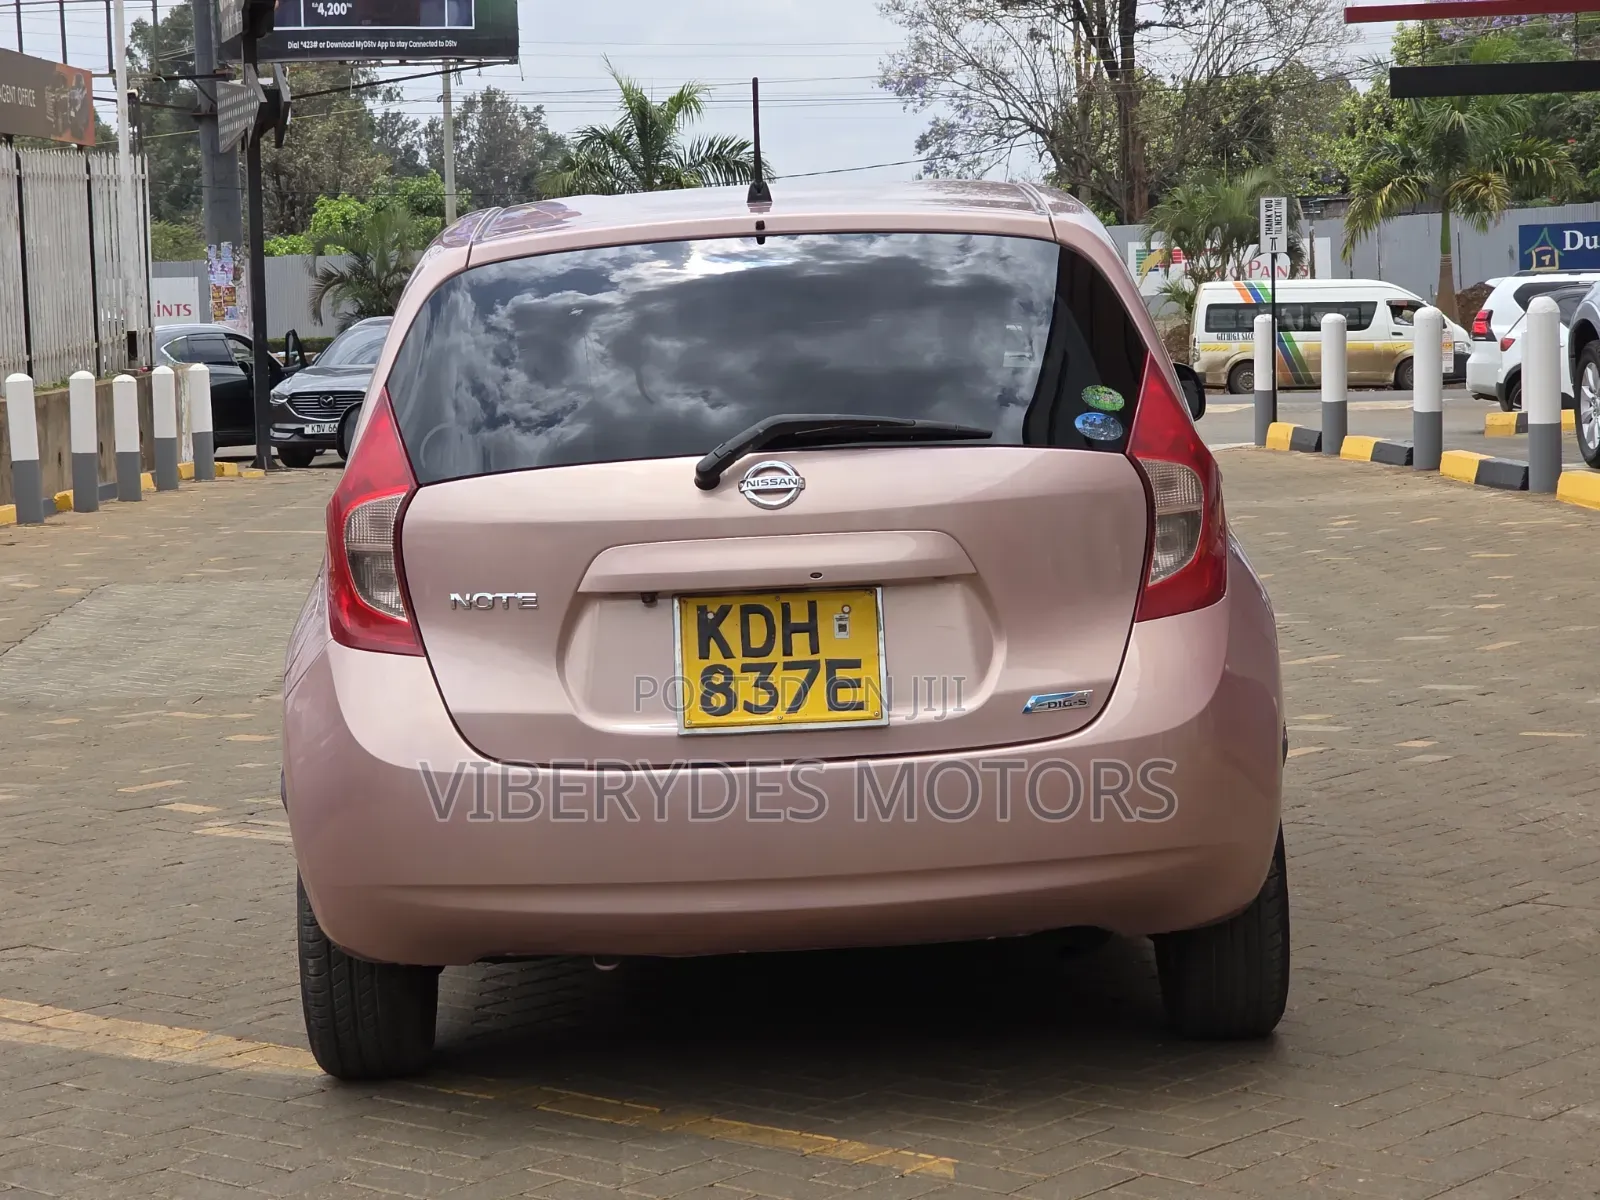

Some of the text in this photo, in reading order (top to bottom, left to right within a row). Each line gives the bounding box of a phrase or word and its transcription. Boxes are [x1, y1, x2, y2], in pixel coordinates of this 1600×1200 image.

[317, 2, 347, 17] 4,200
[287, 41, 300, 49] Dial
[326, 40, 355, 48] Download
[355, 40, 376, 50] MyDStv
[377, 40, 389, 50] App
[389, 40, 396, 48] to
[396, 40, 408, 50] stay
[408, 40, 438, 48] Connected
[438, 40, 445, 48] to
[445, 39, 458, 48] DStv
[17, 86, 36, 108] OFFICE
[1264, 199, 1274, 236] THANK YOU
[1274, 198, 1283, 236] TILL NEXT TIME
[1247, 260, 1309, 279] PANS
[1241, 332, 1255, 341] SACC
[311, 424, 338, 433] KDV 66
[746, 478, 798, 488] NISSAN
[450, 592, 538, 610] NOTE
[696, 600, 820, 660] KDH
[698, 658, 865, 717] 837E
[1046, 698, 1088, 709] DIG-S
